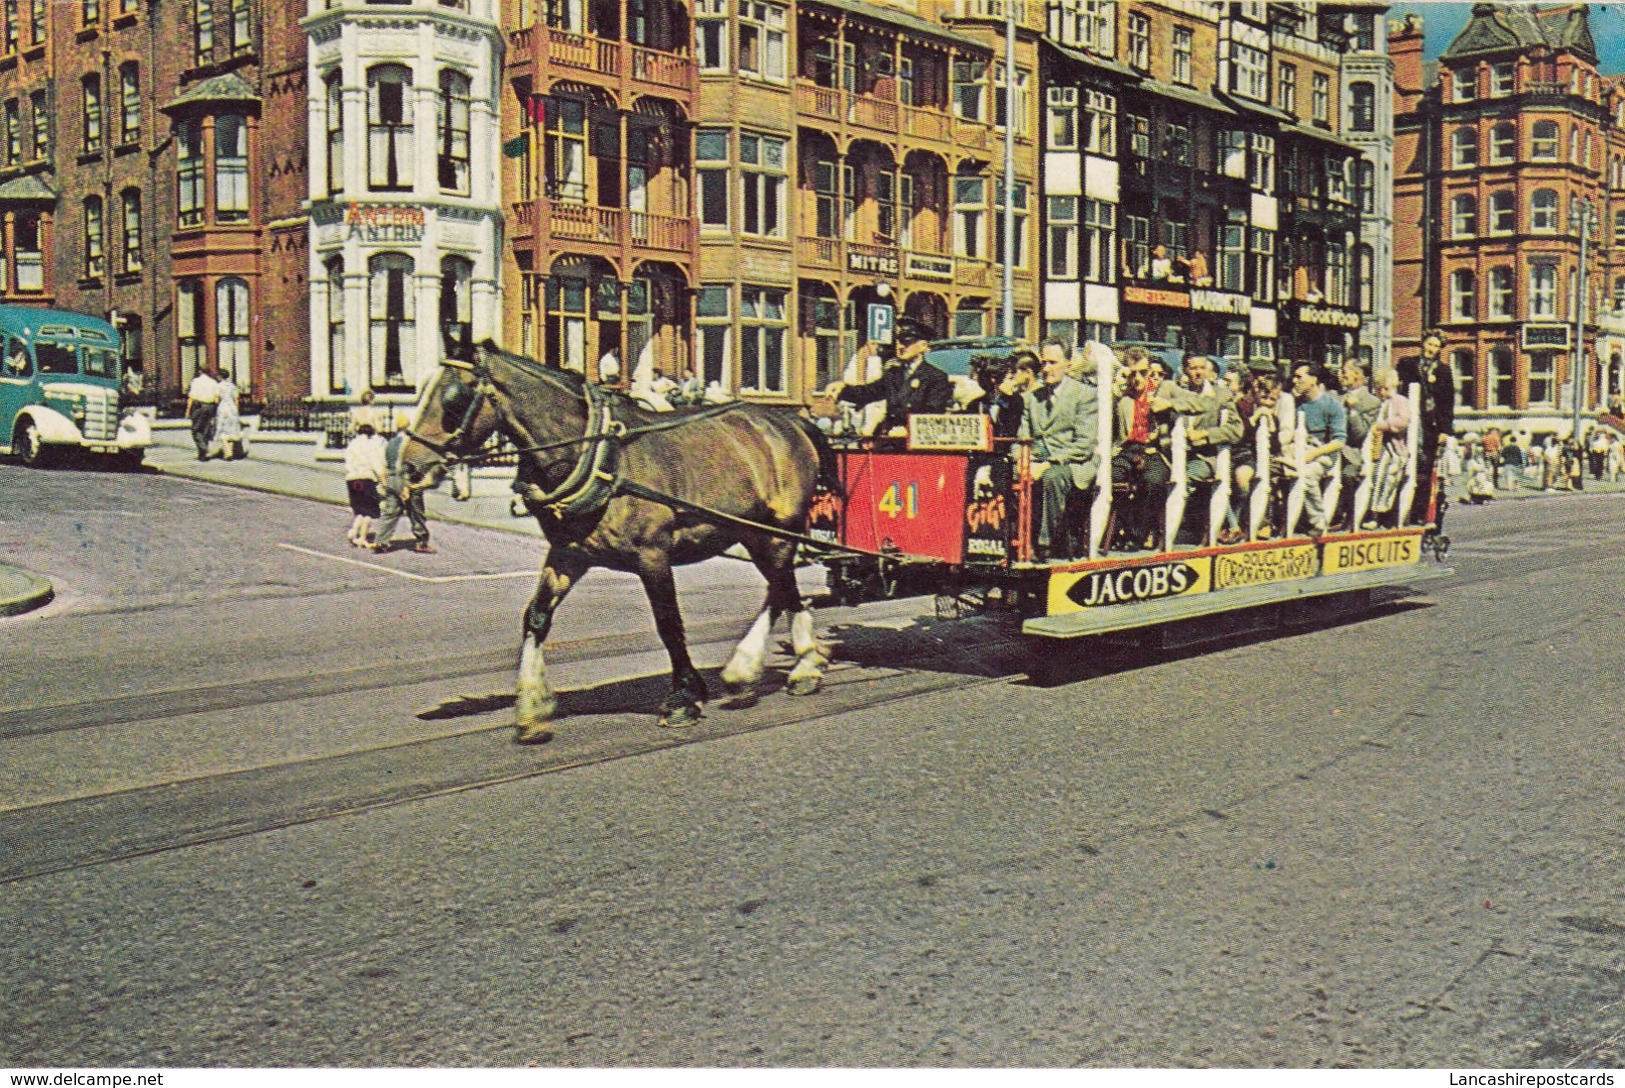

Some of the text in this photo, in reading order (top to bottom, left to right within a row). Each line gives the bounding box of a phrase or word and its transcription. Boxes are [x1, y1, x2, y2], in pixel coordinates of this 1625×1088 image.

[851, 254, 899, 273] MITRE
[874, 308, 887, 339] P
[916, 417, 979, 427] PROMENADES
[879, 482, 917, 519] 41
[1243, 548, 1295, 567] DOUGLAS
[1338, 540, 1411, 568] BISCUITS
[1084, 564, 1187, 605] JACOB'S
